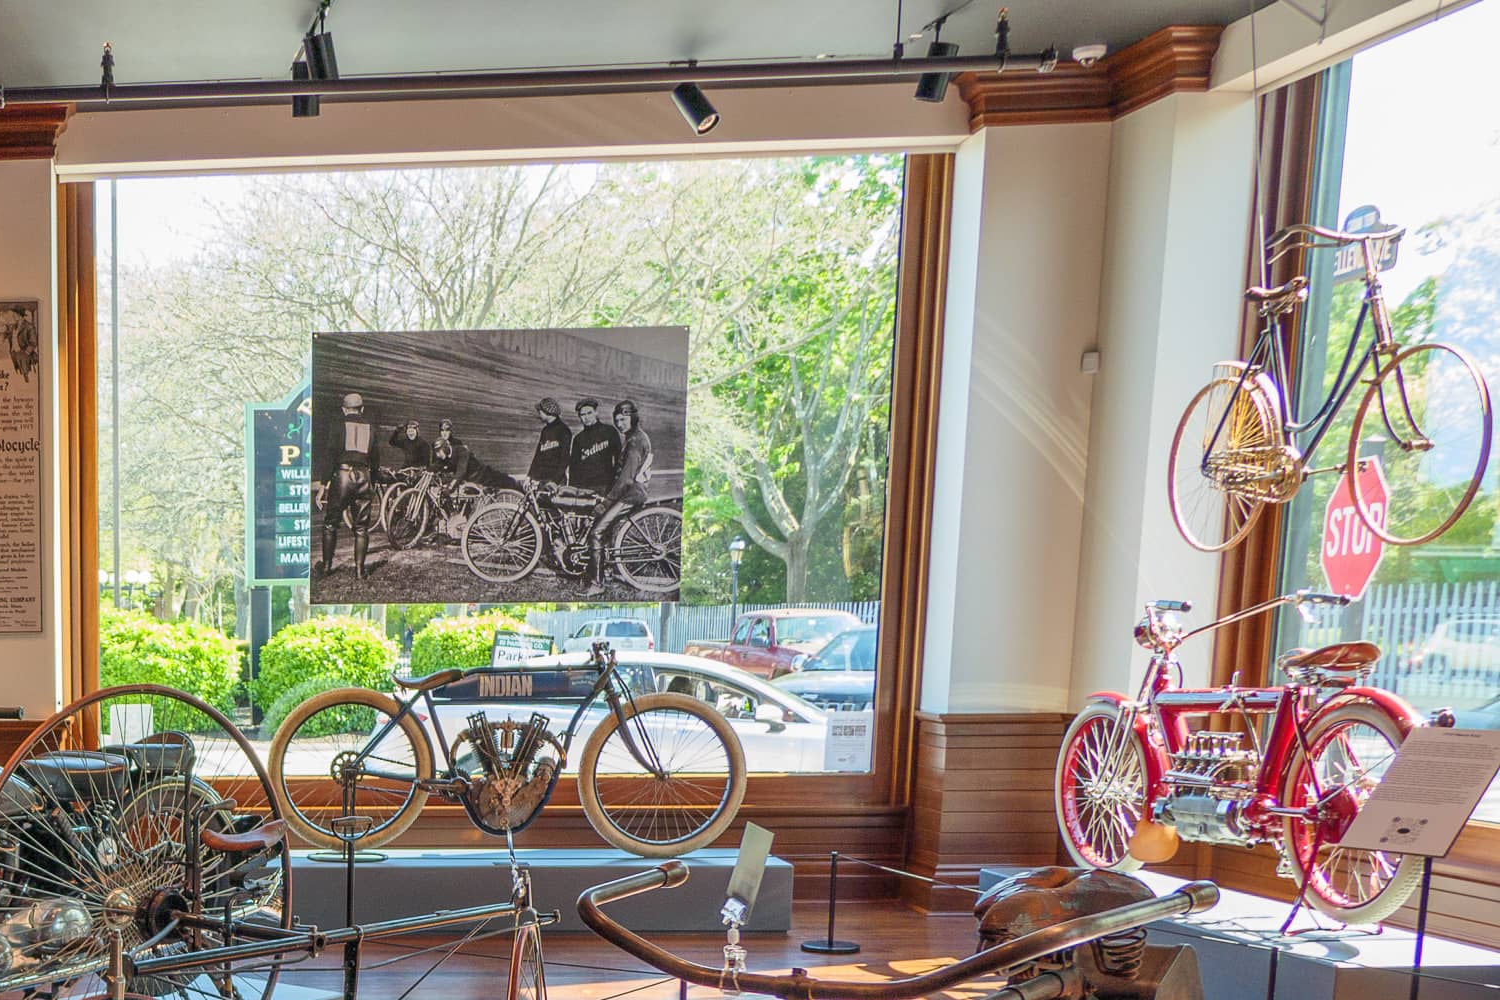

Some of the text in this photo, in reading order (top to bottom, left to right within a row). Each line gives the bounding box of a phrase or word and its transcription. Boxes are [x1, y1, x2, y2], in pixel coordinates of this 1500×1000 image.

[279, 446, 300, 465] P
[1325, 501, 1383, 558] STOP
[279, 536, 309, 547] LIFEST
[479, 674, 533, 697] INDIAN
